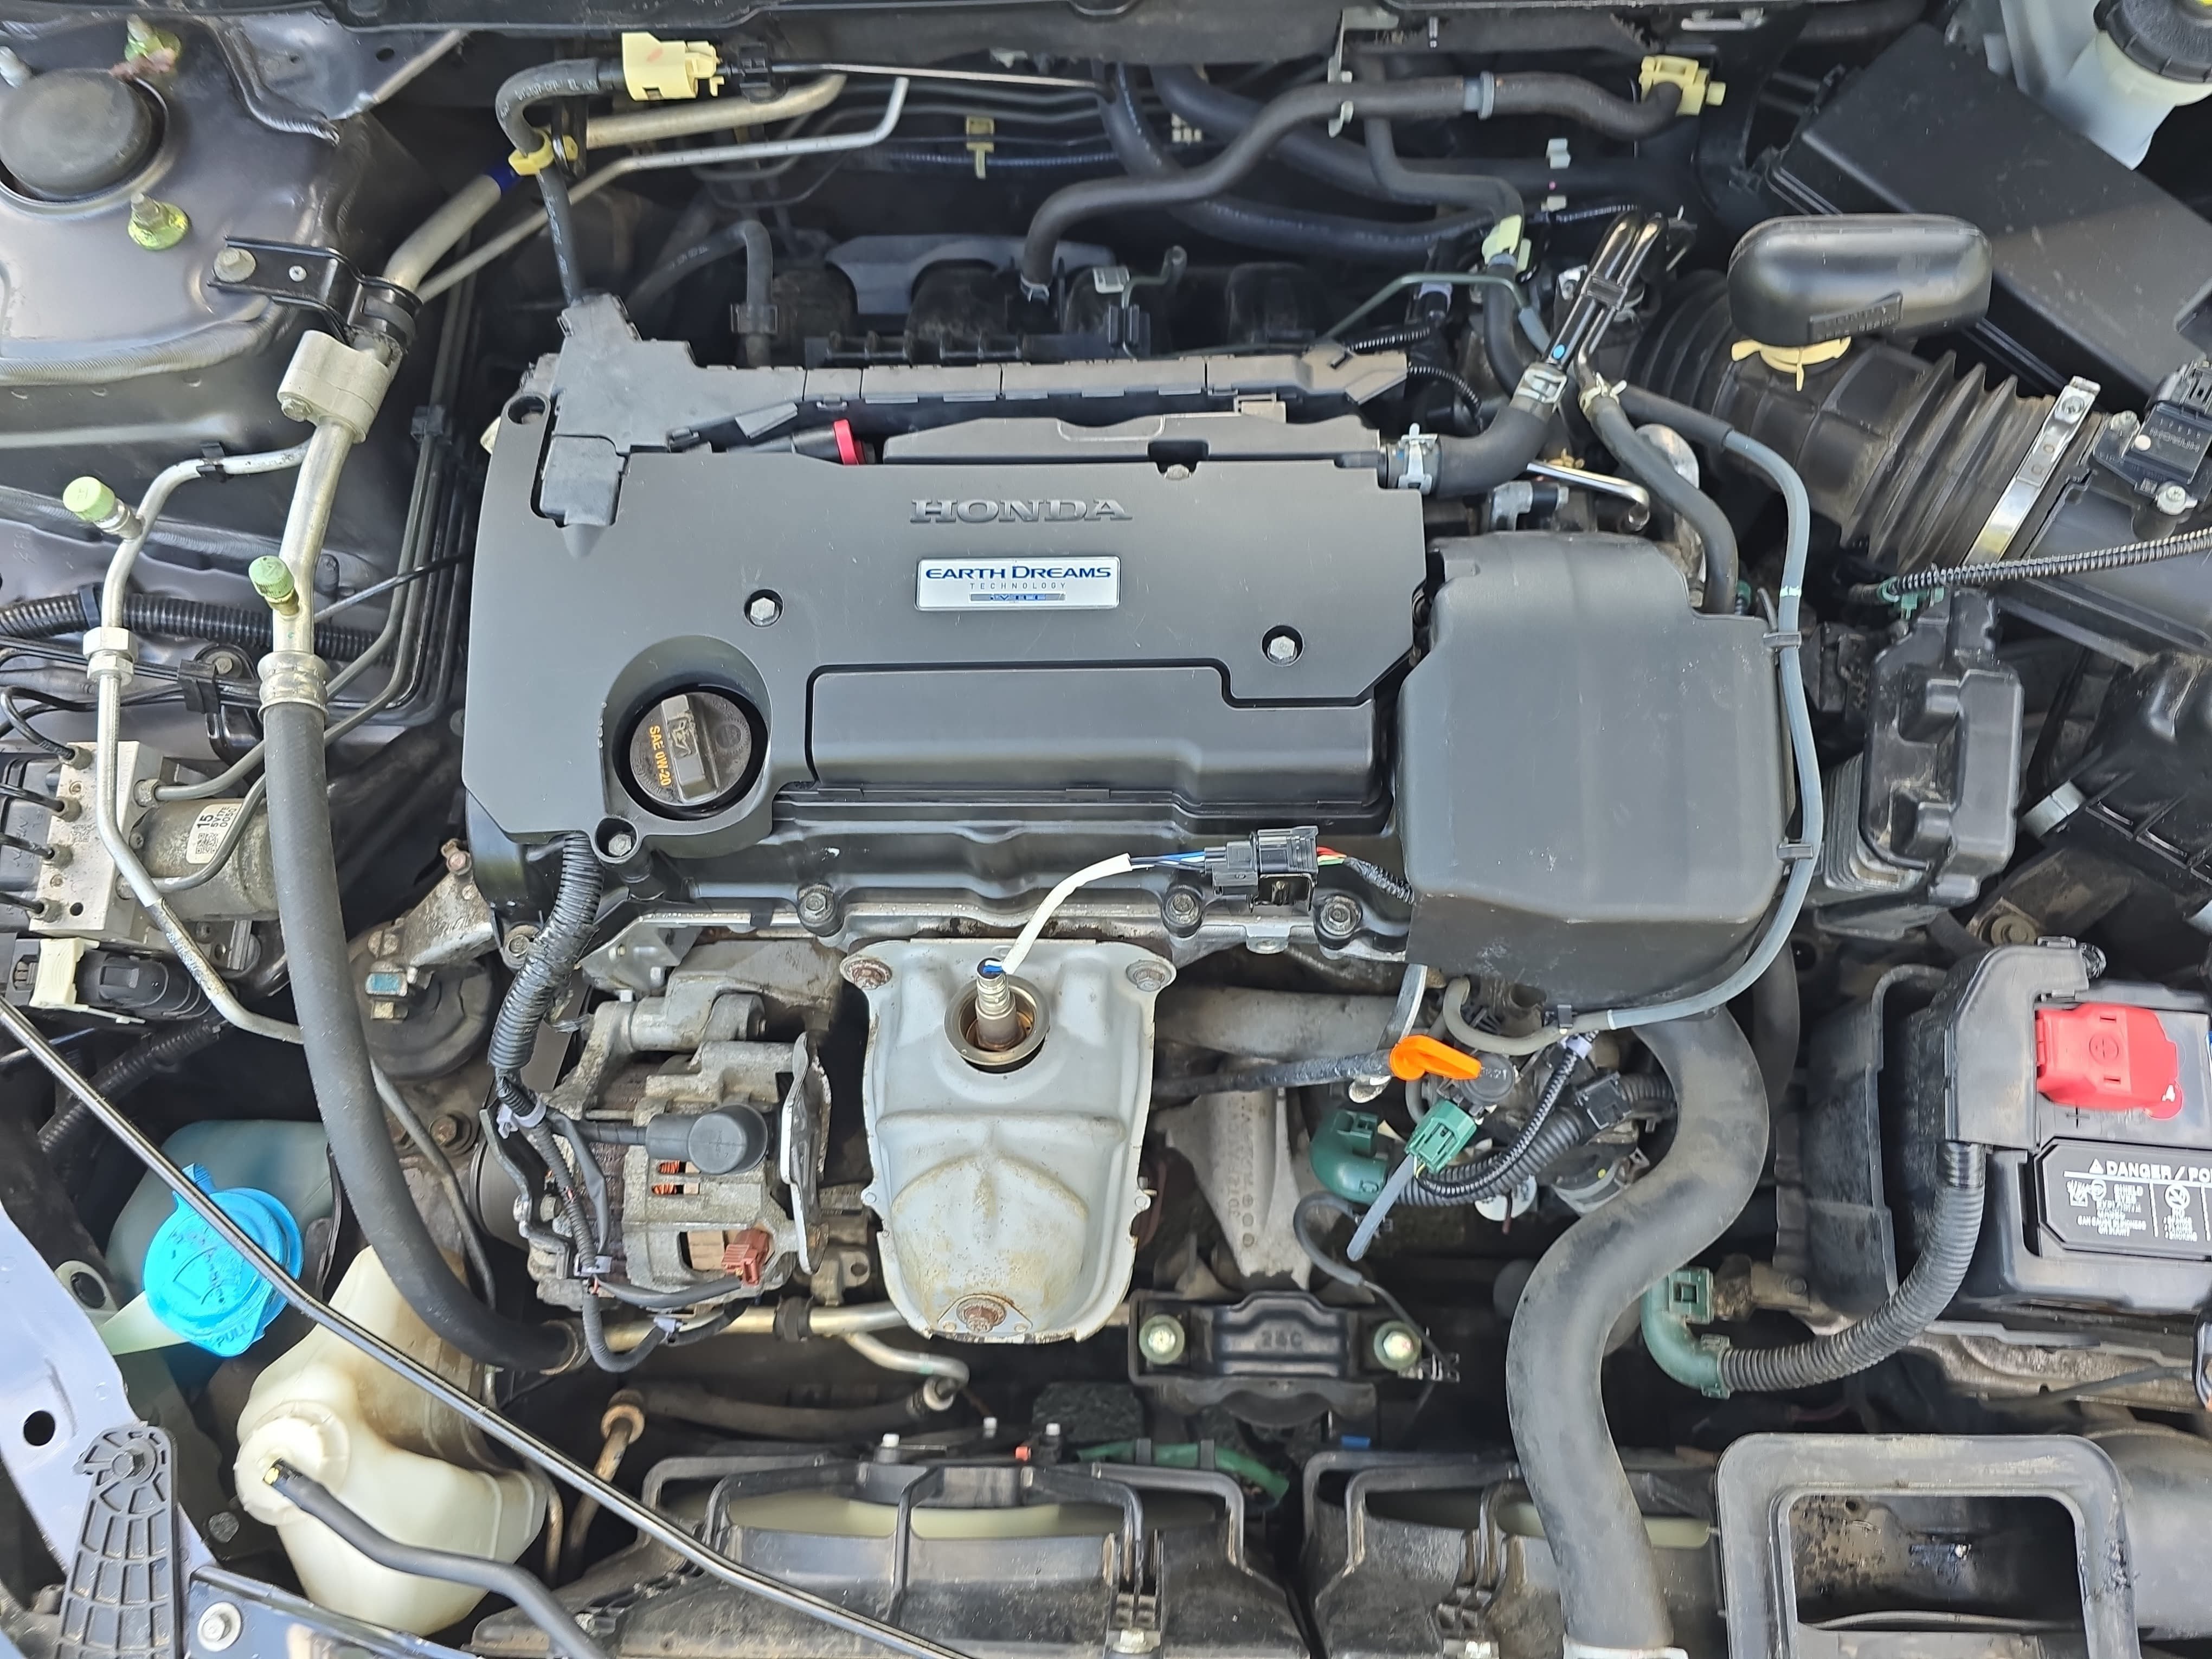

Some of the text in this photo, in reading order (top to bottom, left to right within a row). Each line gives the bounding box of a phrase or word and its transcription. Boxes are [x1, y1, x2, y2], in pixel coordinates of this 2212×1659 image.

[910, 498, 1133, 523] HONDA
[925, 565, 1111, 579] EARTH DREAMS
[650, 725, 672, 786] SAE 0W-20
[197, 815, 214, 829] 15
[2106, 1160, 2171, 1180] DANGER
[2188, 1167, 2212, 1183] PO
[217, 1324, 251, 1348] PULL
